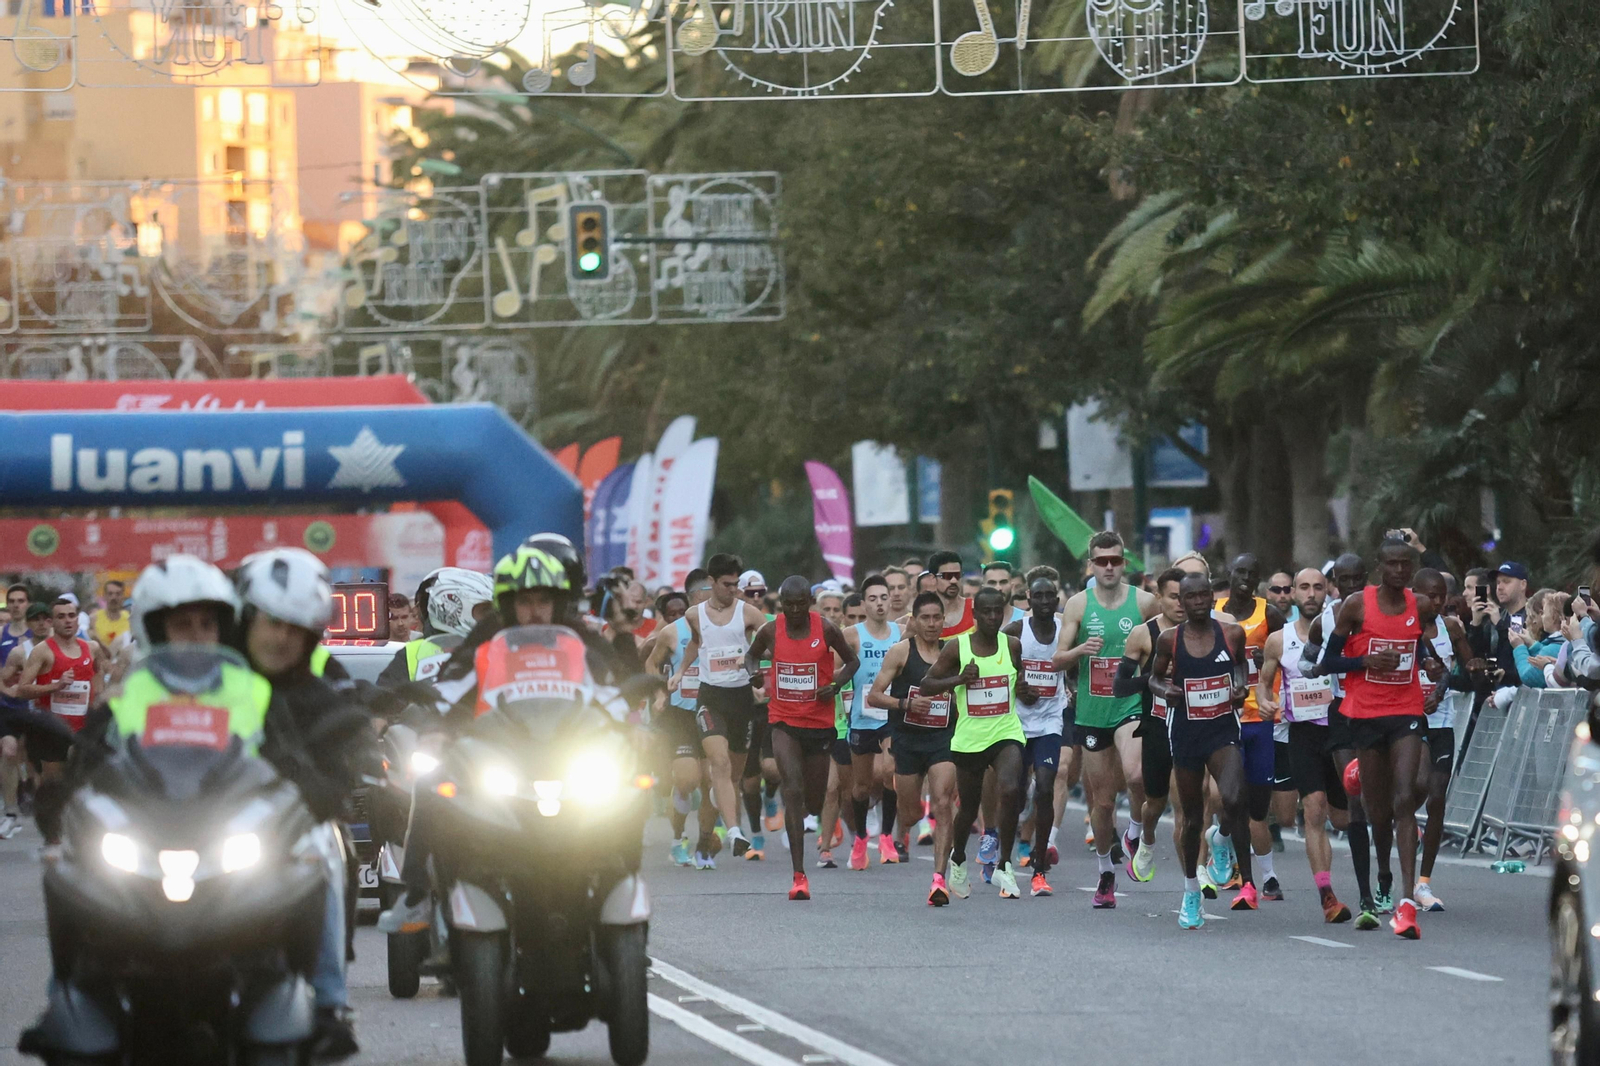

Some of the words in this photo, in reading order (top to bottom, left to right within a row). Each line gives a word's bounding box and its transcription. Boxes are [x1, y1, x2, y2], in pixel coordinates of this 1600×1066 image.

[51, 430, 305, 493] luanvi
[864, 647, 889, 659] ner
[780, 676, 813, 684] MBURUGU
[1199, 691, 1220, 700] MITEI
[1300, 692, 1322, 700] 14493
